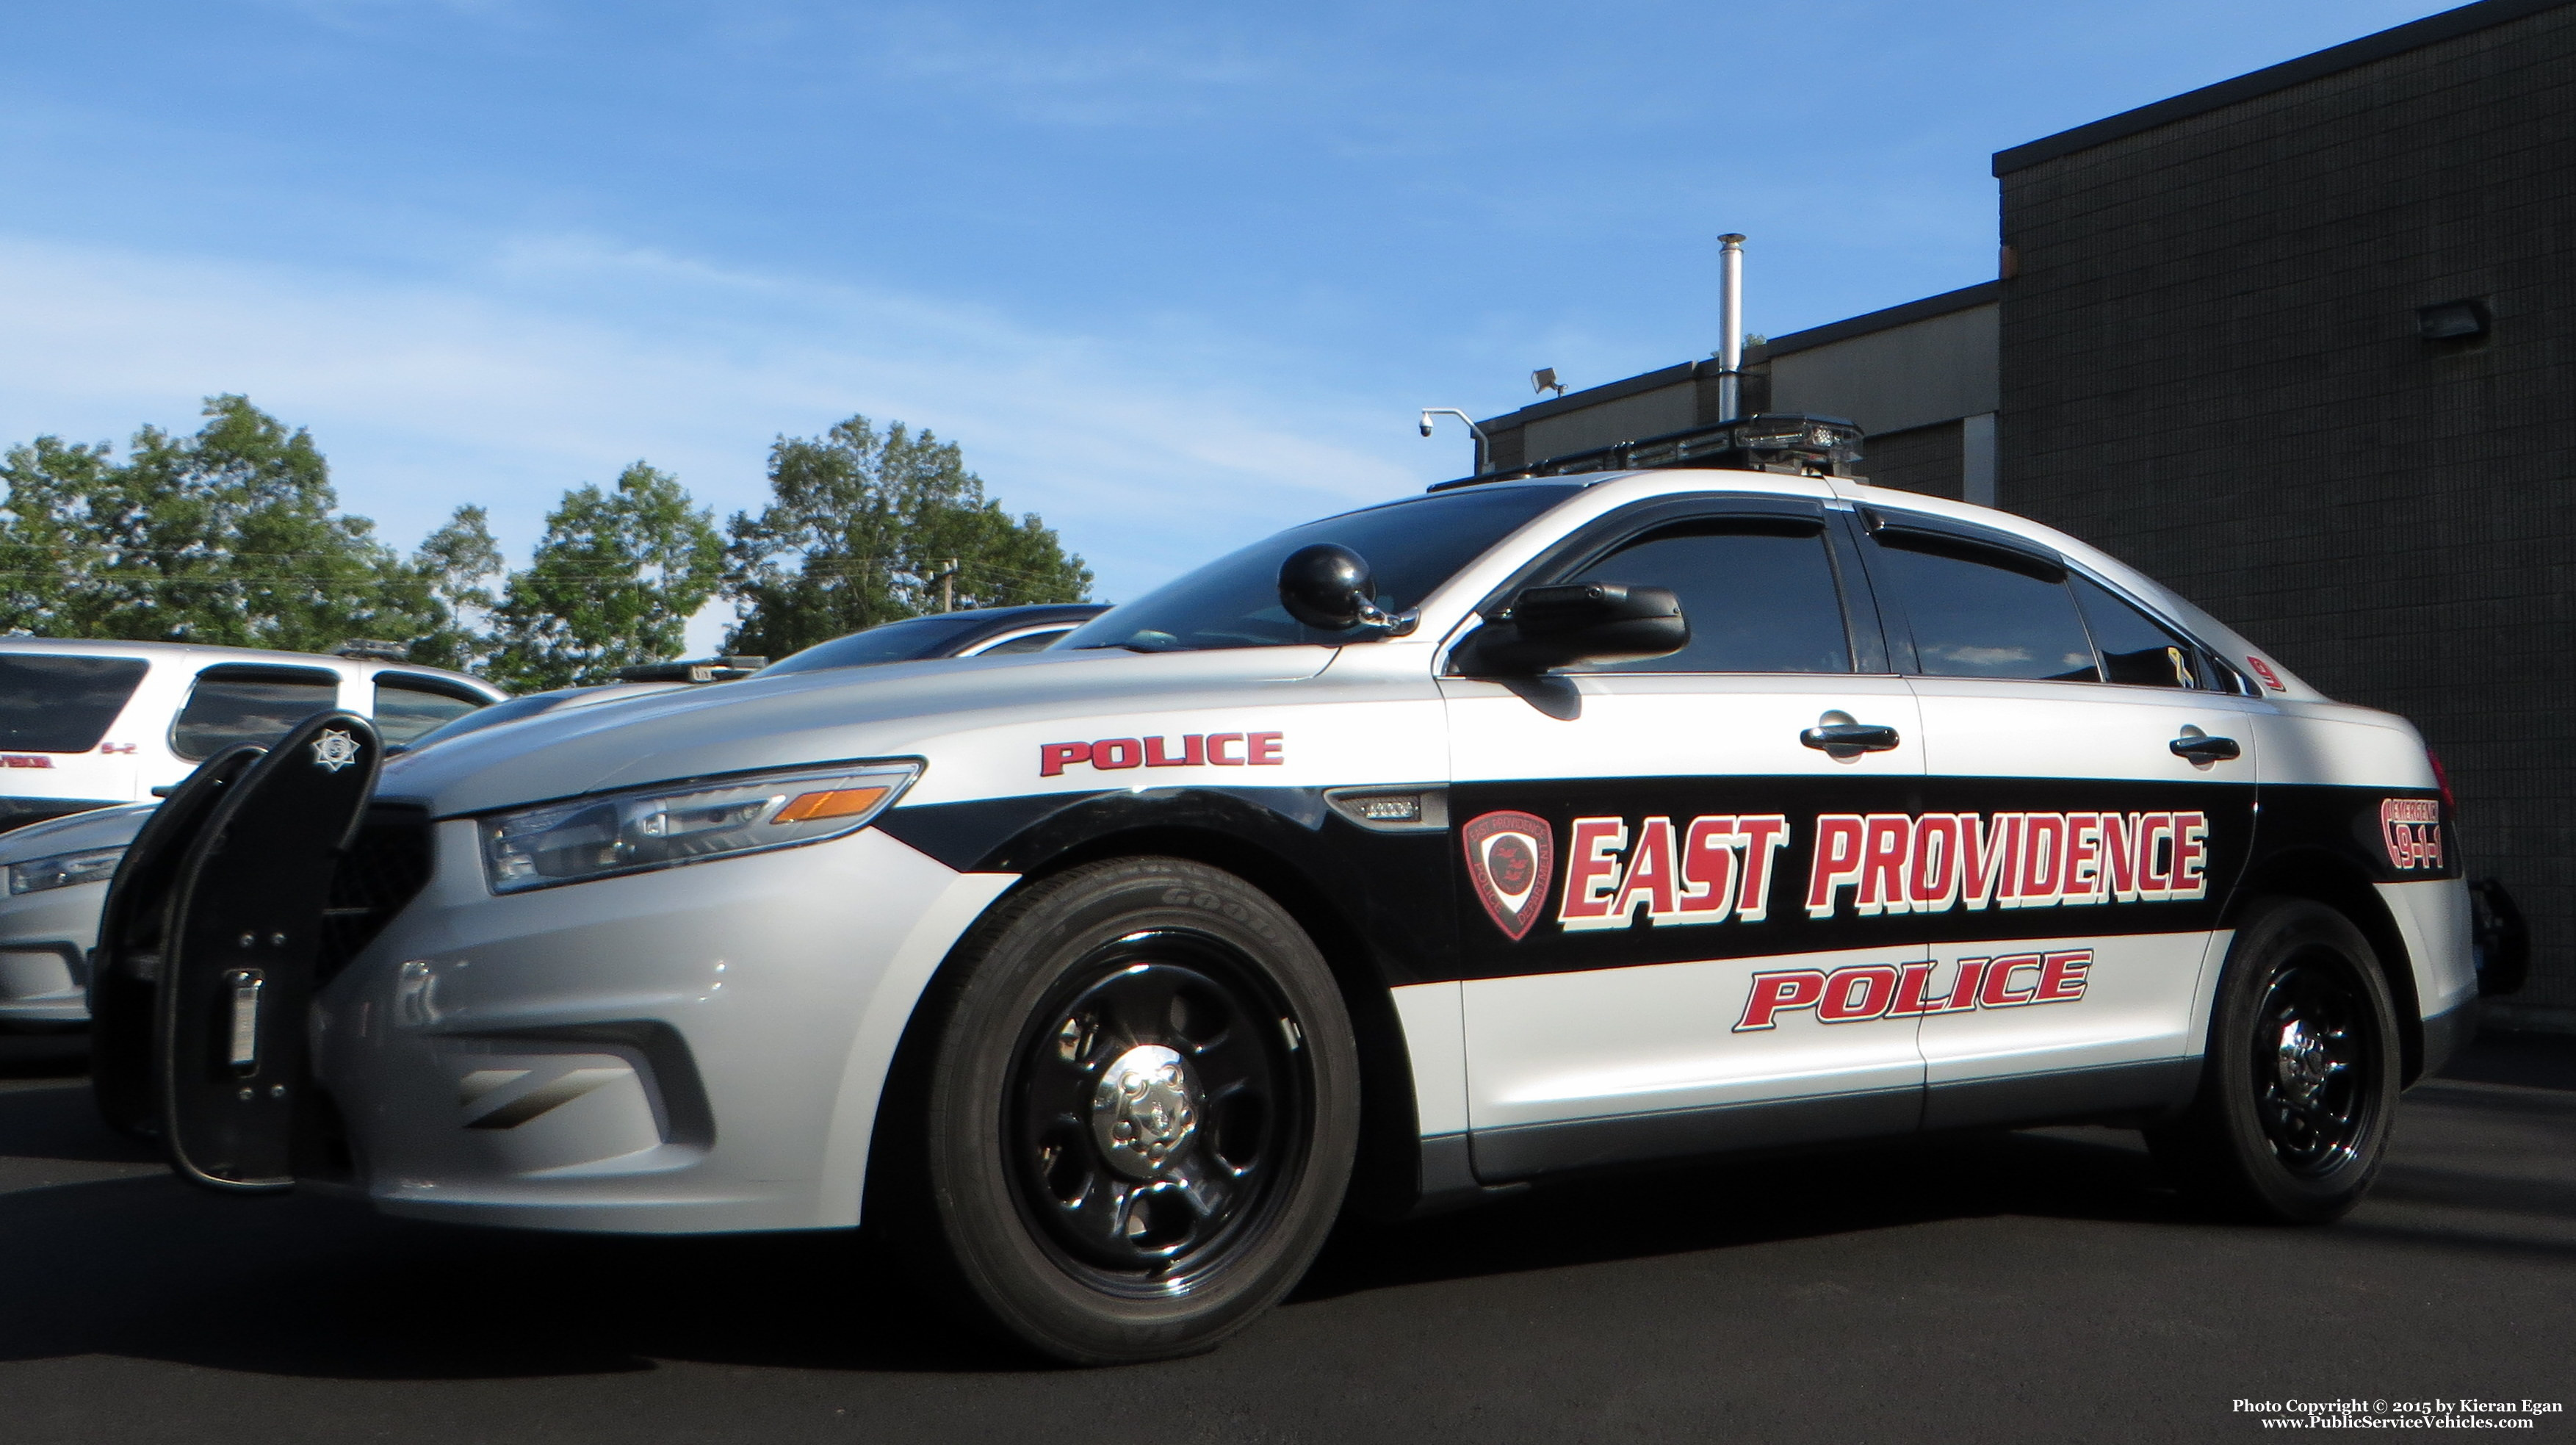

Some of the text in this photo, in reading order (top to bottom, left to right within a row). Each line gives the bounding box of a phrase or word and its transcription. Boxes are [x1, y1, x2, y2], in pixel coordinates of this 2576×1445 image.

[2246, 655, 2287, 692] 9
[1039, 731, 1285, 776] POLICE
[1469, 817, 1547, 841] EAST PROVIDENCE
[2392, 801, 2439, 823] EMERGENC
[2396, 824, 2443, 869] 9-1-1
[1474, 862, 1503, 913] POLICE
[1516, 843, 1550, 926] DEPARTMENT
[1558, 814, 1790, 931] EAST
[1805, 811, 2209, 920] PROVIDENCE
[1731, 948, 2095, 1034] POLICE
